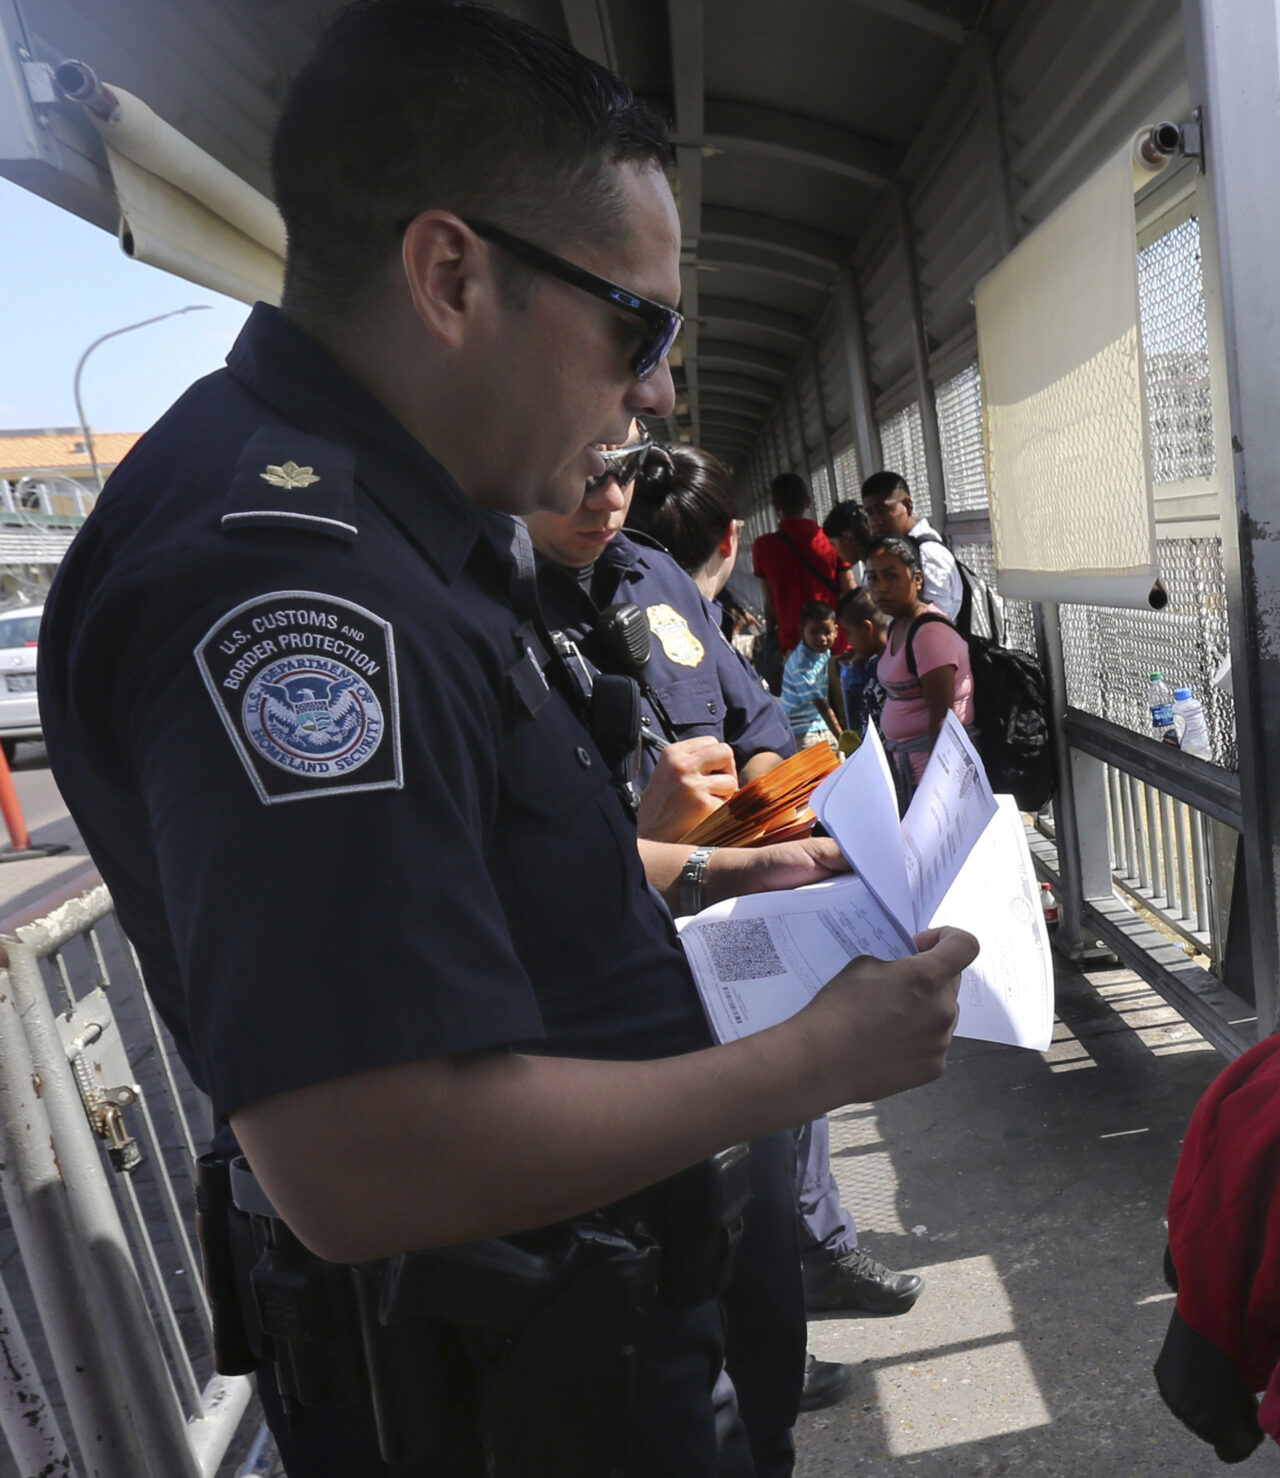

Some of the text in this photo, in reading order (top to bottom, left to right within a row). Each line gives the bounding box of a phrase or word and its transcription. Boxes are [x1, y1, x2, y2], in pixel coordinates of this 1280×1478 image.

[219, 610, 365, 655] U.S. CUSTOMS AND
[223, 632, 381, 690] BORDER PROTECTION
[261, 658, 359, 688] DEPARTMENT
[356, 686, 374, 704] OF
[252, 717, 381, 773] HOMELAND SECURITY
